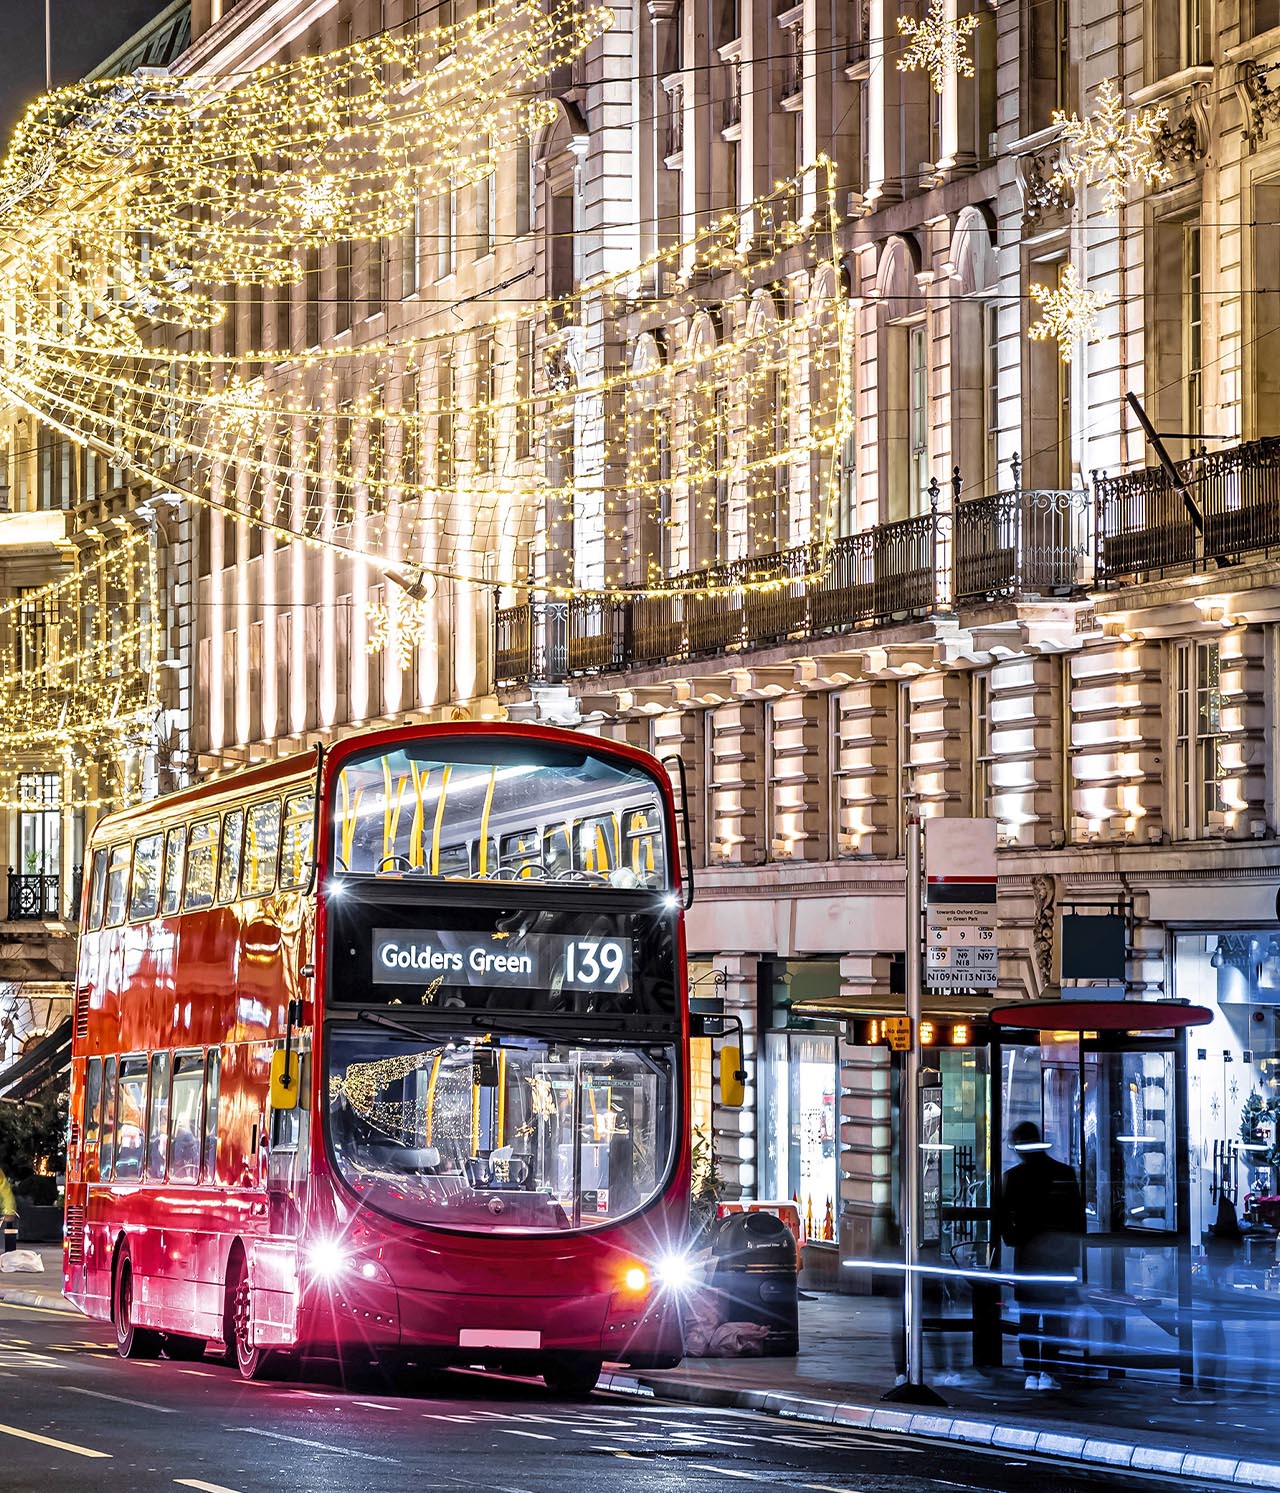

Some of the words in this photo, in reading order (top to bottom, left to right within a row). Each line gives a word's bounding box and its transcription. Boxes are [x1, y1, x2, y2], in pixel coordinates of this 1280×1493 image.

[936, 931, 942, 940] 6
[959, 931, 966, 940] 9
[979, 931, 993, 940] 139
[381, 943, 463, 971] Golders
[470, 947, 531, 974] Green
[931, 952, 946, 960] 159
[977, 952, 995, 961] N97
[566, 942, 624, 984] 139
[927, 973, 950, 981] N109
[951, 973, 974, 981] N113
[975, 973, 997, 981] N136
[458, 1410, 835, 1434] STOP
[571, 1429, 926, 1453] BUS
